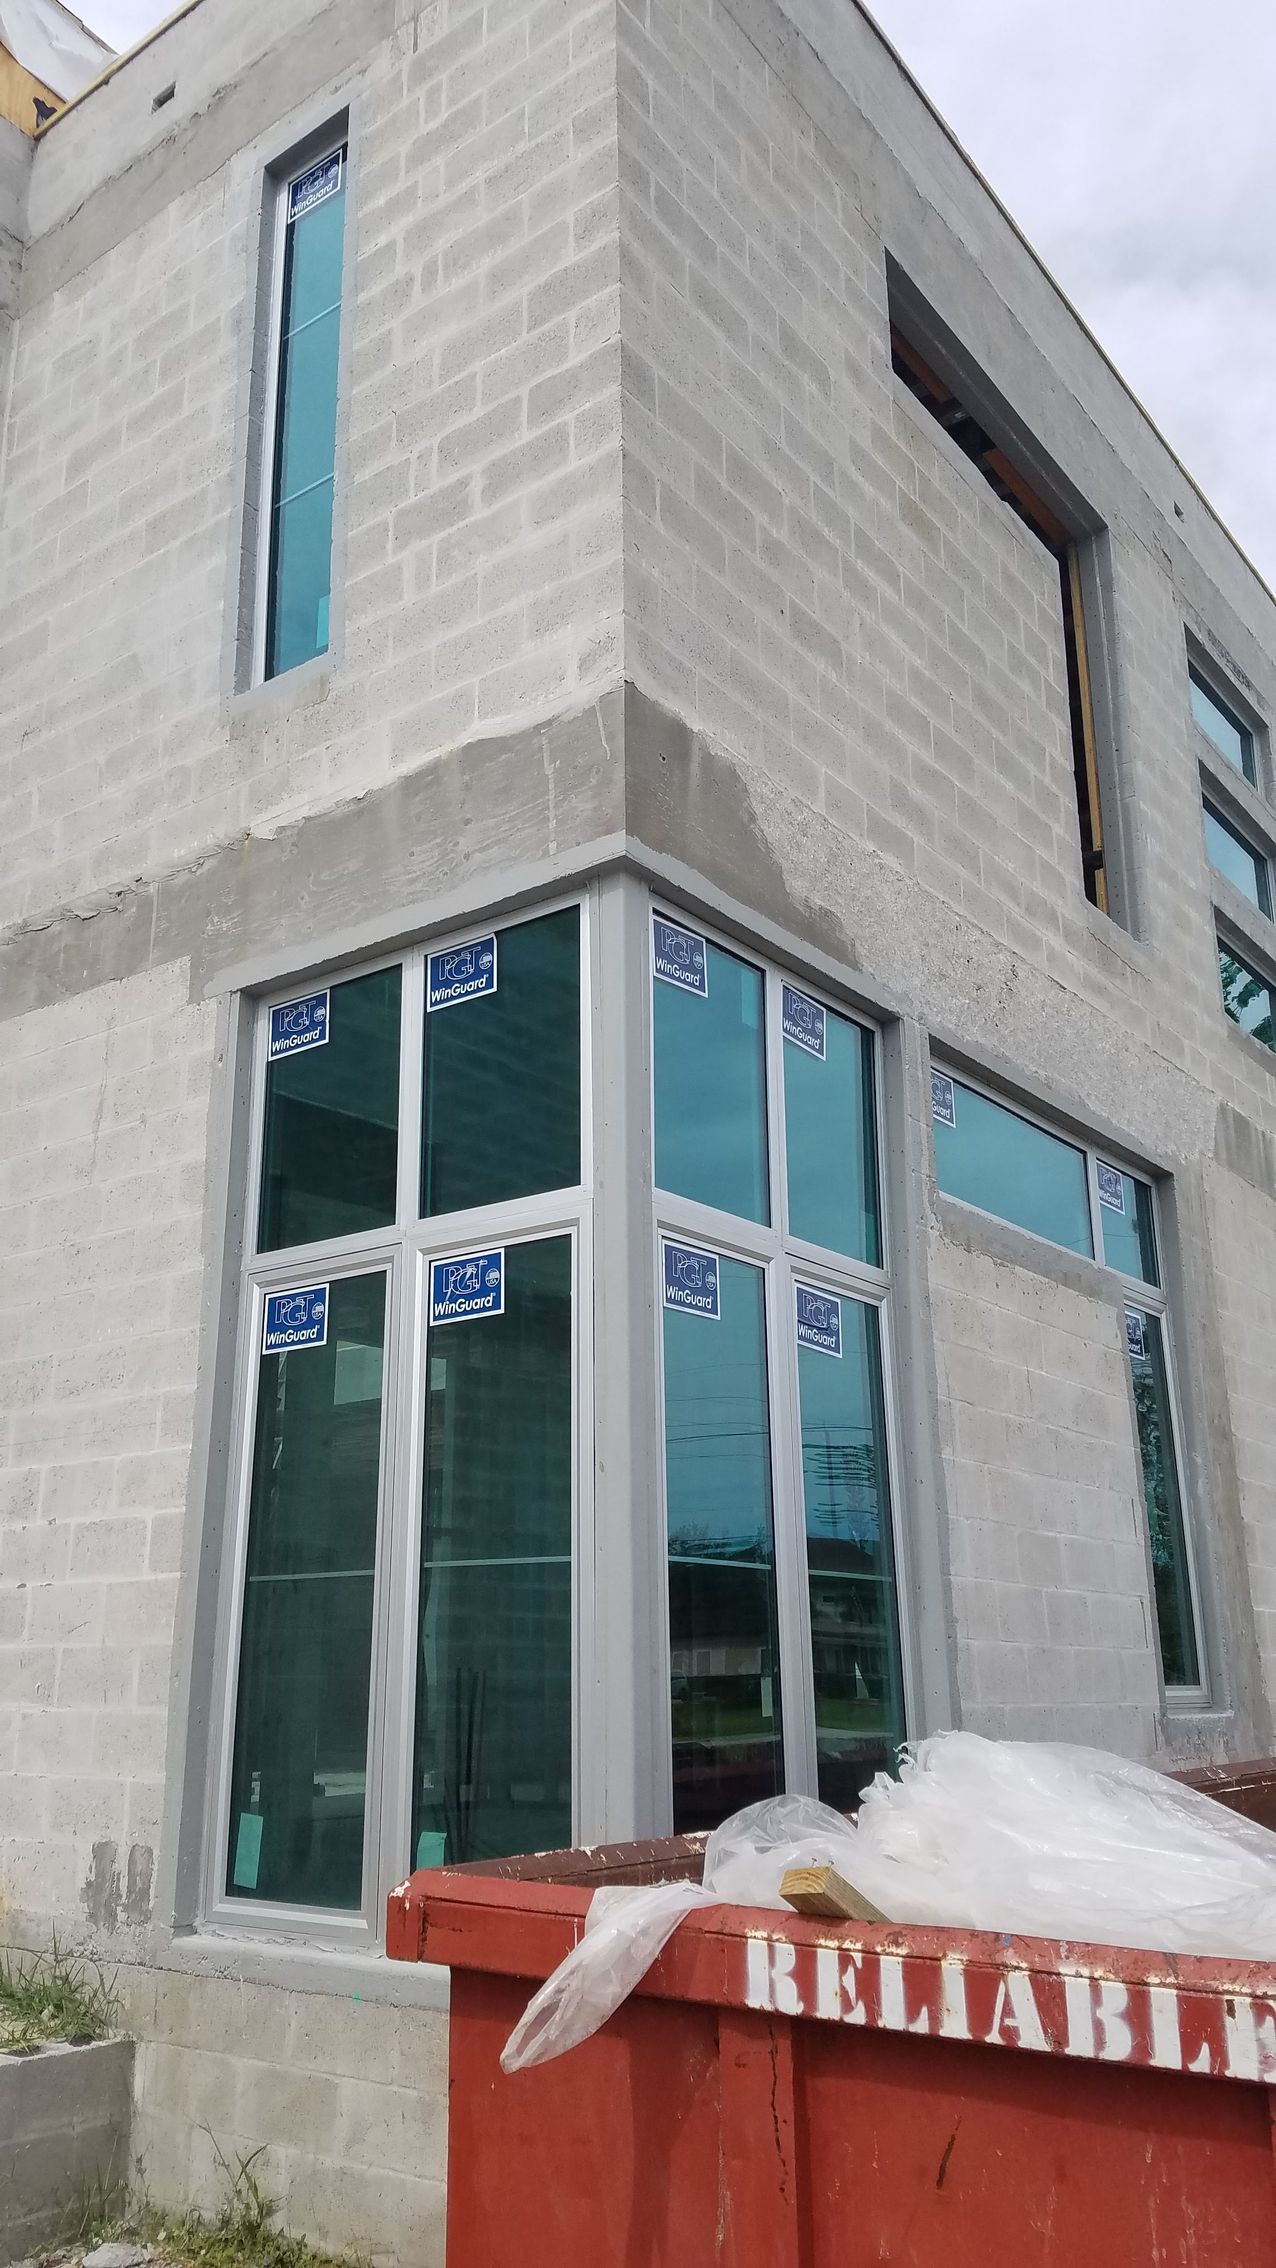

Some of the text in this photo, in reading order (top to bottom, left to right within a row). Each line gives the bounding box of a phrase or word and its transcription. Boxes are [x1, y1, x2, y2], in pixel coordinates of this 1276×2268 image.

[291, 180, 334, 217] WinGuard
[439, 946, 481, 981] PGT
[656, 956, 700, 987] WinGuard
[431, 974, 488, 1003] WinGuard
[279, 1000, 316, 1032] PGT
[272, 1027, 321, 1053] WinGuard
[783, 1018, 820, 1049] WinGuard
[931, 1100, 950, 1119] Guard
[443, 1259, 488, 1295] PGT
[275, 1294, 315, 1326] PGT
[434, 1292, 495, 1317] WinGuard
[666, 1284, 713, 1309] WinGuard
[267, 1325, 319, 1346] WinGuard
[798, 1323, 836, 1348] WinGuard
[745, 1932, 1276, 2085] RELIABLE
